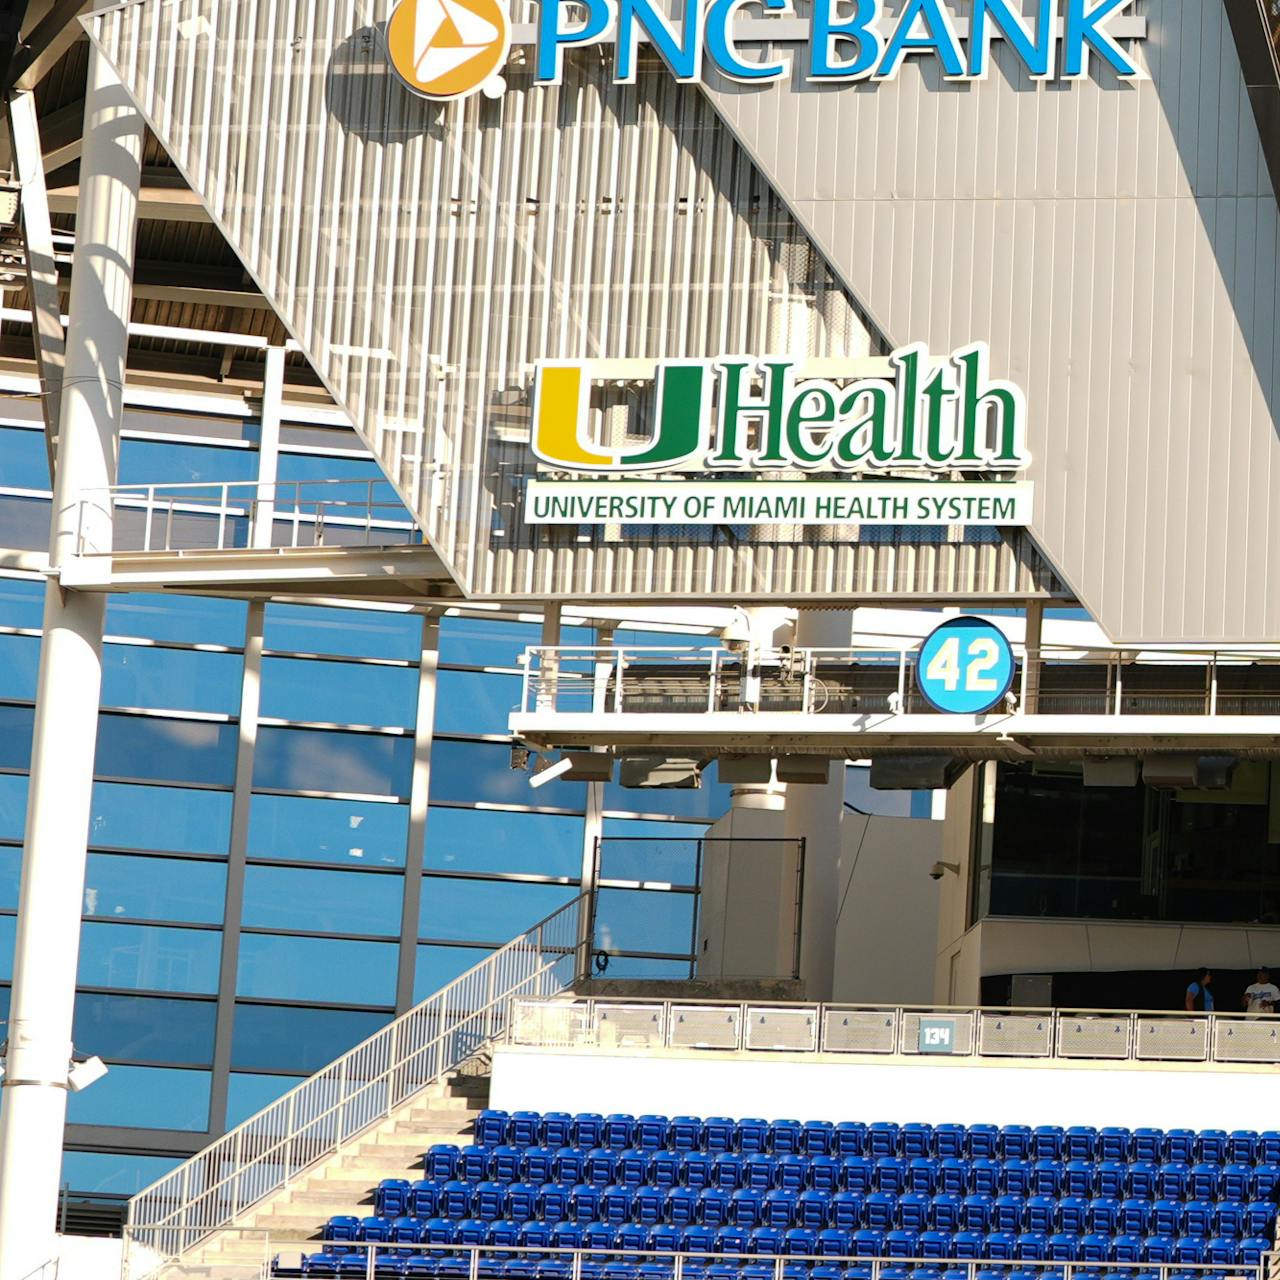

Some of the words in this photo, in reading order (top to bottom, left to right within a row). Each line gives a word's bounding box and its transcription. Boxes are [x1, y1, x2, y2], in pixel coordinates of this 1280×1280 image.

[533, 495, 677, 519] UNIVERSITY
[684, 495, 715, 519] OF
[722, 496, 806, 519] MIAMI
[815, 496, 907, 519] HEALTH
[916, 496, 1017, 520] SYSTEM
[925, 636, 1001, 692] 42
[924, 1027, 950, 1045] 134
